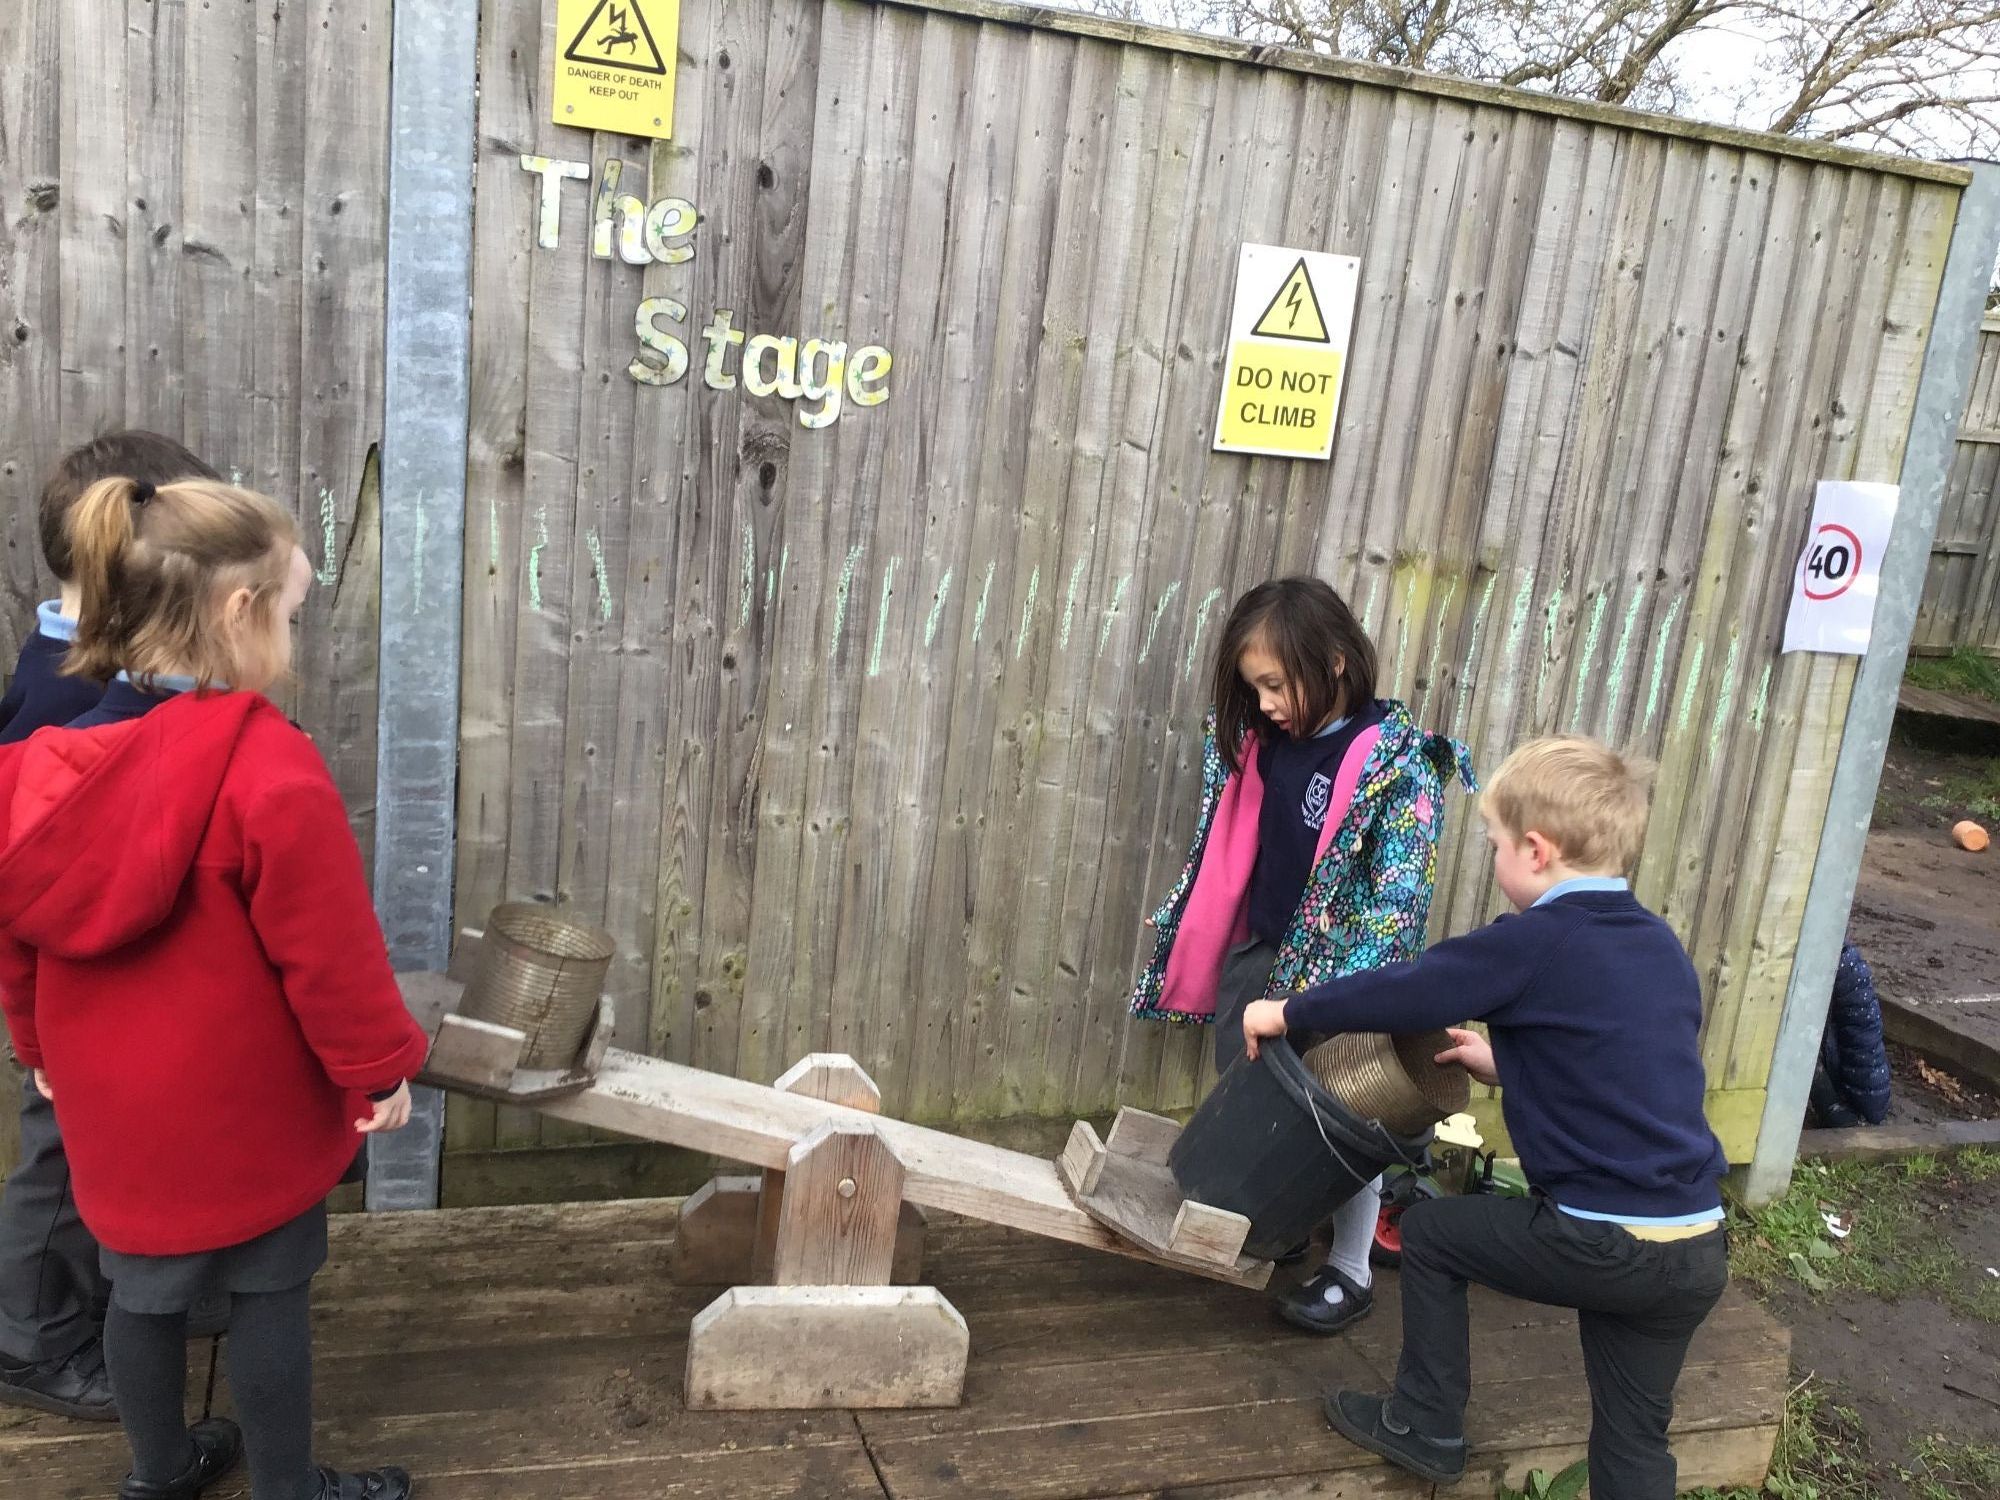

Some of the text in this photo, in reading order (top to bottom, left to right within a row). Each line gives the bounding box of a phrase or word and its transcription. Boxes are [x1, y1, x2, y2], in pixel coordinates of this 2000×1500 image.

[567, 66, 662, 90] DANGER OF DEATH
[589, 85, 639, 101] KEEP OUT
[520, 154, 697, 265] The
[628, 297, 893, 428] Stage
[1236, 365, 1332, 395] DO NOT
[1240, 402, 1317, 428] CLIMB
[1808, 545, 1850, 580] 40
